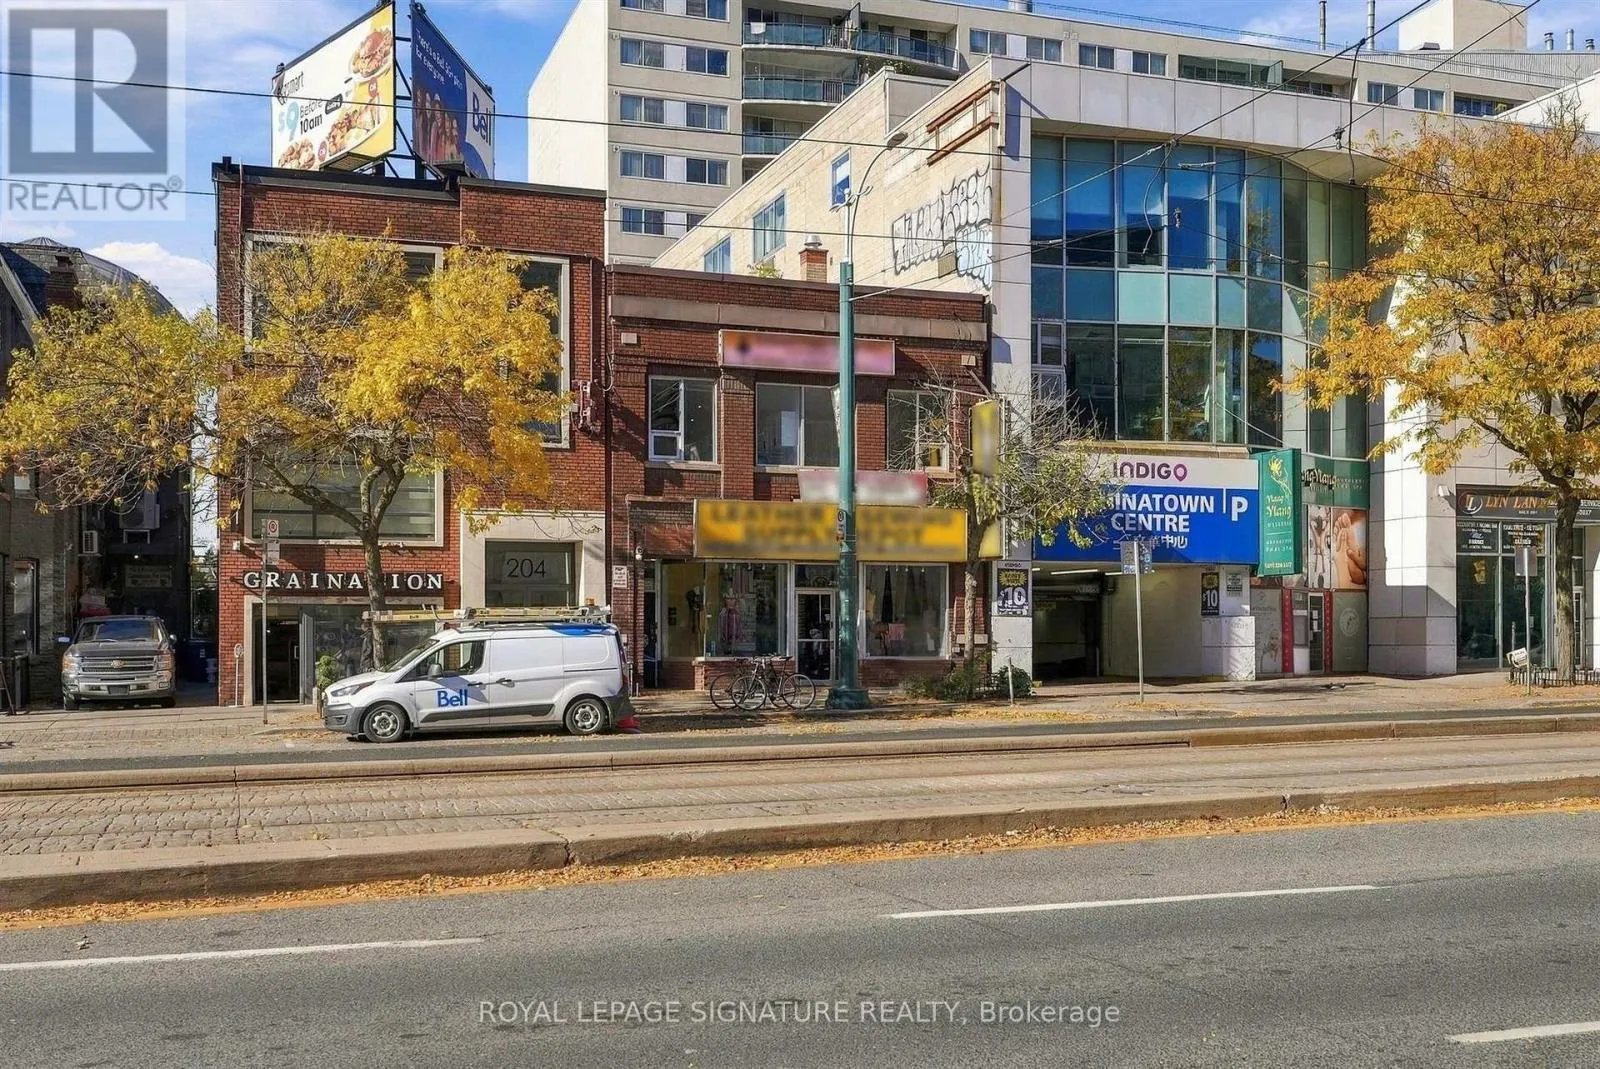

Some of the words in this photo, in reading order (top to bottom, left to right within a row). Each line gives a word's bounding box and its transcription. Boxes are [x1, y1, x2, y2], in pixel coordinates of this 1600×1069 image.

[299, 114, 323, 135] 10am
[472, 91, 492, 146] Bell
[1110, 492, 1215, 513] INATOWN
[1231, 496, 1248, 521] P
[1266, 505, 1292, 519] Ylang
[1485, 495, 1509, 509] LYN
[1513, 496, 1539, 510] LAN
[1111, 512, 1190, 533] CENTRE
[506, 558, 547, 579] 204
[243, 571, 443, 590] GRAINAION
[437, 688, 468, 708] Bell
